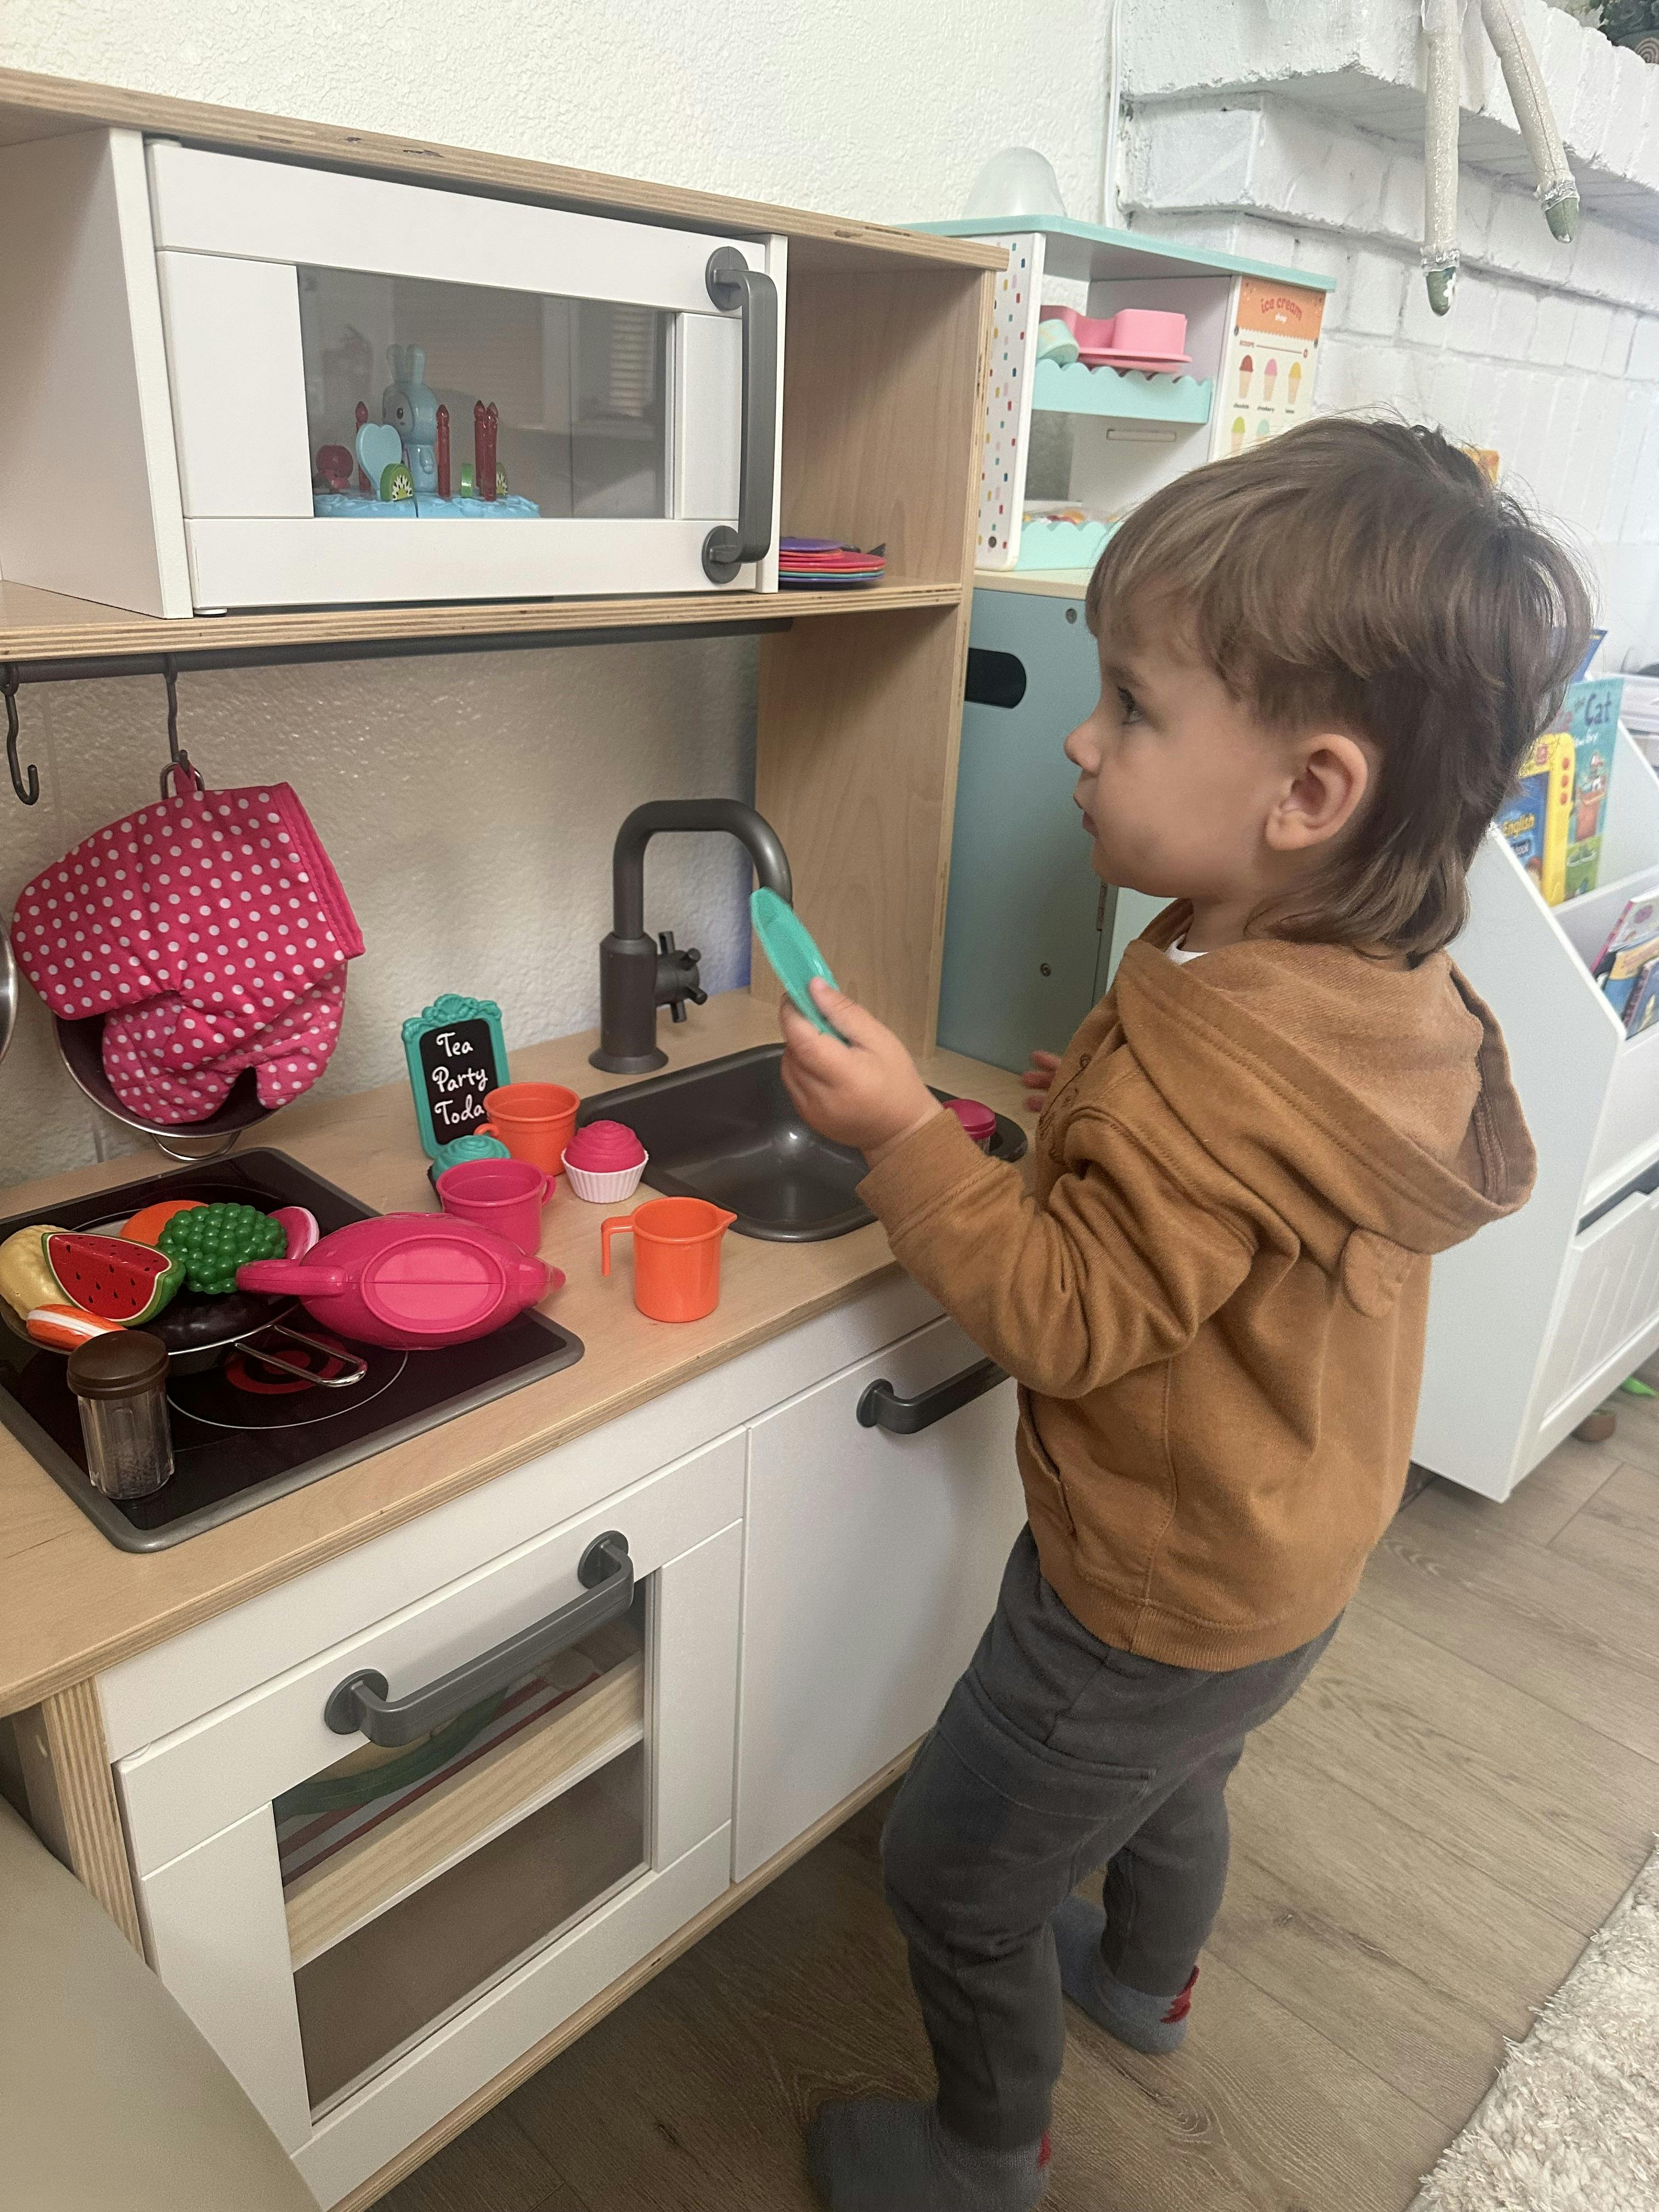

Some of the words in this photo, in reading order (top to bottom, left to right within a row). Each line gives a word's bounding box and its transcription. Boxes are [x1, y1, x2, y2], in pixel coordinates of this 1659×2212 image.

[1261, 298, 1274, 313] ice
[1277, 298, 1302, 321] cream
[1585, 691, 1612, 727] Cat
[436, 1031, 474, 1058] Tea
[431, 1066, 488, 1093] Party
[434, 1094, 485, 1125] Toda
